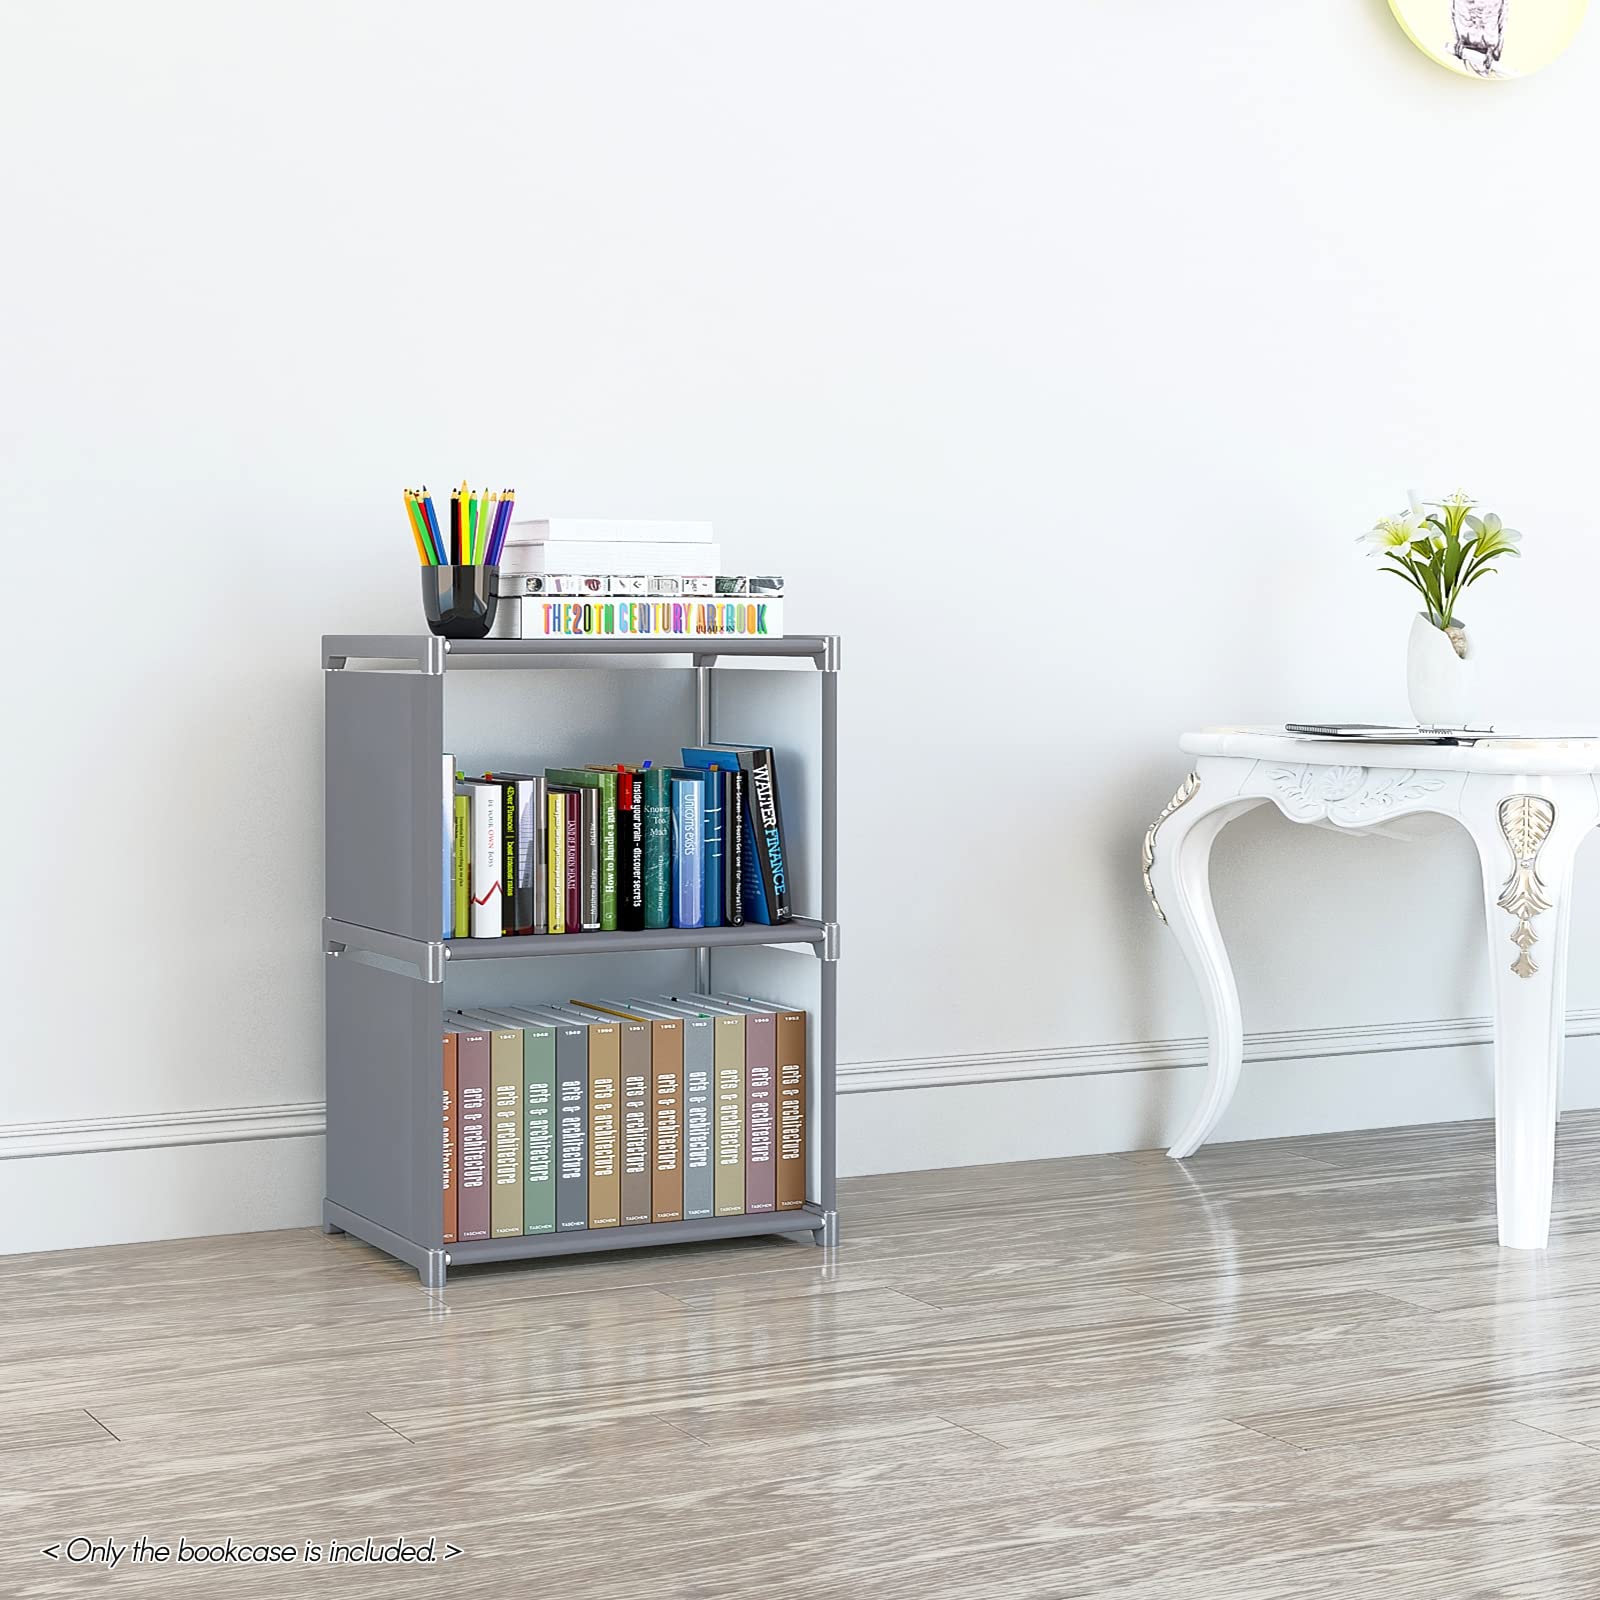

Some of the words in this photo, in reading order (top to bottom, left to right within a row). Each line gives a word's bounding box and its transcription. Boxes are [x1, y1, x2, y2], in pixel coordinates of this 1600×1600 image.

[619, 602, 693, 635] CENTURY
[632, 782, 642, 804] Inside
[752, 764, 778, 829] WALTER
[607, 806, 616, 823] gun
[630, 804, 641, 822] your
[684, 794, 695, 831] Unicorns
[568, 820, 576, 836] LAND
[632, 822, 642, 842] brain
[568, 837, 576, 845] OF
[604, 832, 614, 861] handle
[684, 832, 696, 856] exists
[606, 862, 614, 870] to
[632, 848, 642, 880] discover
[764, 828, 786, 896] FINANCE
[606, 873, 614, 893] How
[632, 880, 642, 907] secrets
[657, 1073, 679, 1094] arts
[689, 1071, 710, 1092] arts
[720, 1069, 741, 1089] arts
[751, 1067, 772, 1087] arts
[781, 1064, 802, 1085] arts
[496, 1085, 519, 1106] arts
[529, 1083, 551, 1104] arts
[561, 1080, 584, 1102] arts
[594, 1078, 616, 1099] arts
[626, 1076, 648, 1097] arts
[463, 1087, 486, 1109] arts
[561, 1105, 581, 1113] &
[657, 1109, 681, 1171] architecture
[689, 1107, 711, 1168] architecture
[720, 1104, 742, 1165] architecture
[751, 1102, 774, 1162] architecture
[781, 1099, 804, 1160] architecture
[497, 1122, 521, 1185] architecture
[529, 1119, 553, 1182] architecture
[561, 1116, 586, 1179] architecture
[594, 1114, 618, 1176] architecture
[626, 1112, 649, 1173] architecture
[463, 1124, 488, 1188] architecture
